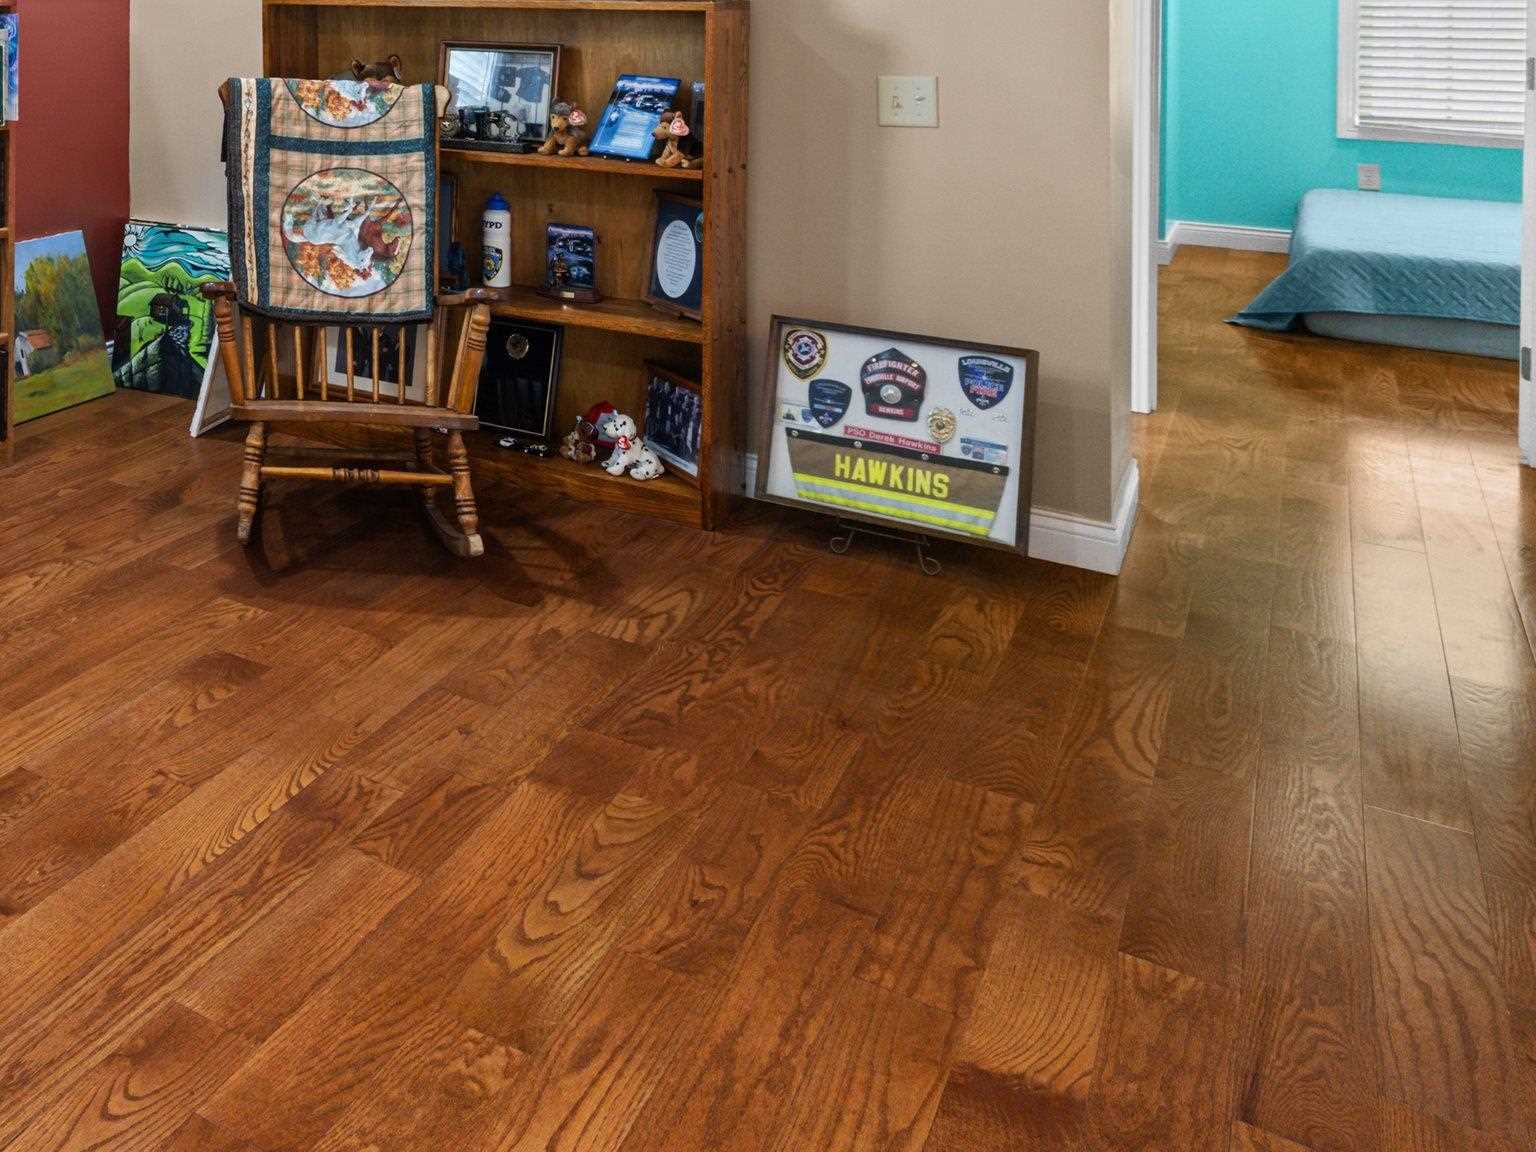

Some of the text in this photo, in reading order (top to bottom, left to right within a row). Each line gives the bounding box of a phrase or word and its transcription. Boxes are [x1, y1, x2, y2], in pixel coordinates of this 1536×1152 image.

[846, 427, 939, 453] PSO Derek Hawkins
[834, 453, 950, 498] HAWKINS
